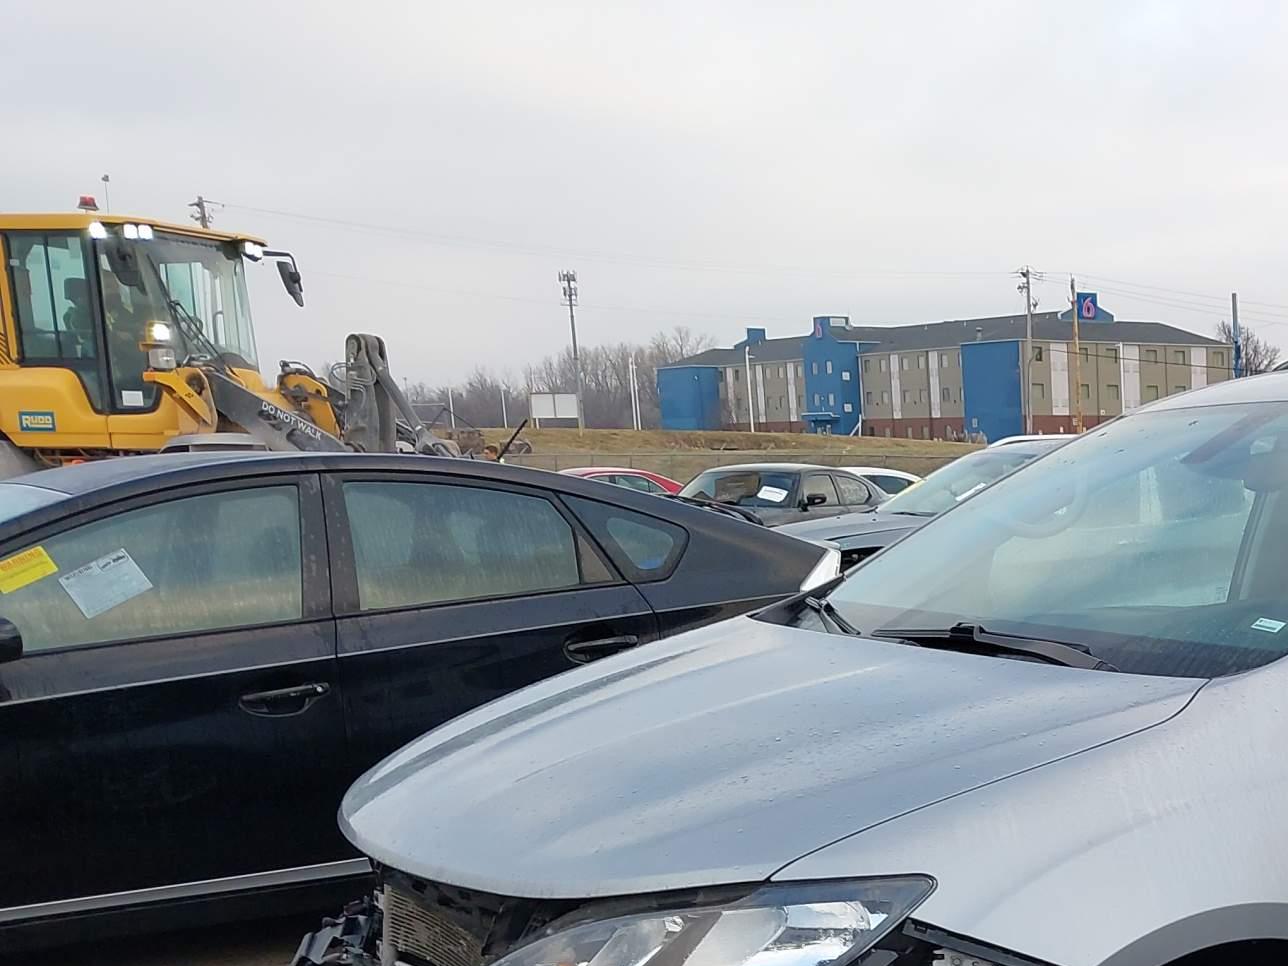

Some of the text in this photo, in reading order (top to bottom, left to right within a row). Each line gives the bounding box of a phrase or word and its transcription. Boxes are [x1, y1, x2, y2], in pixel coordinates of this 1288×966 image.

[1082, 296, 1095, 318] 6
[21, 415, 53, 428] RUDD
[261, 401, 321, 440] DO NOT WALK
